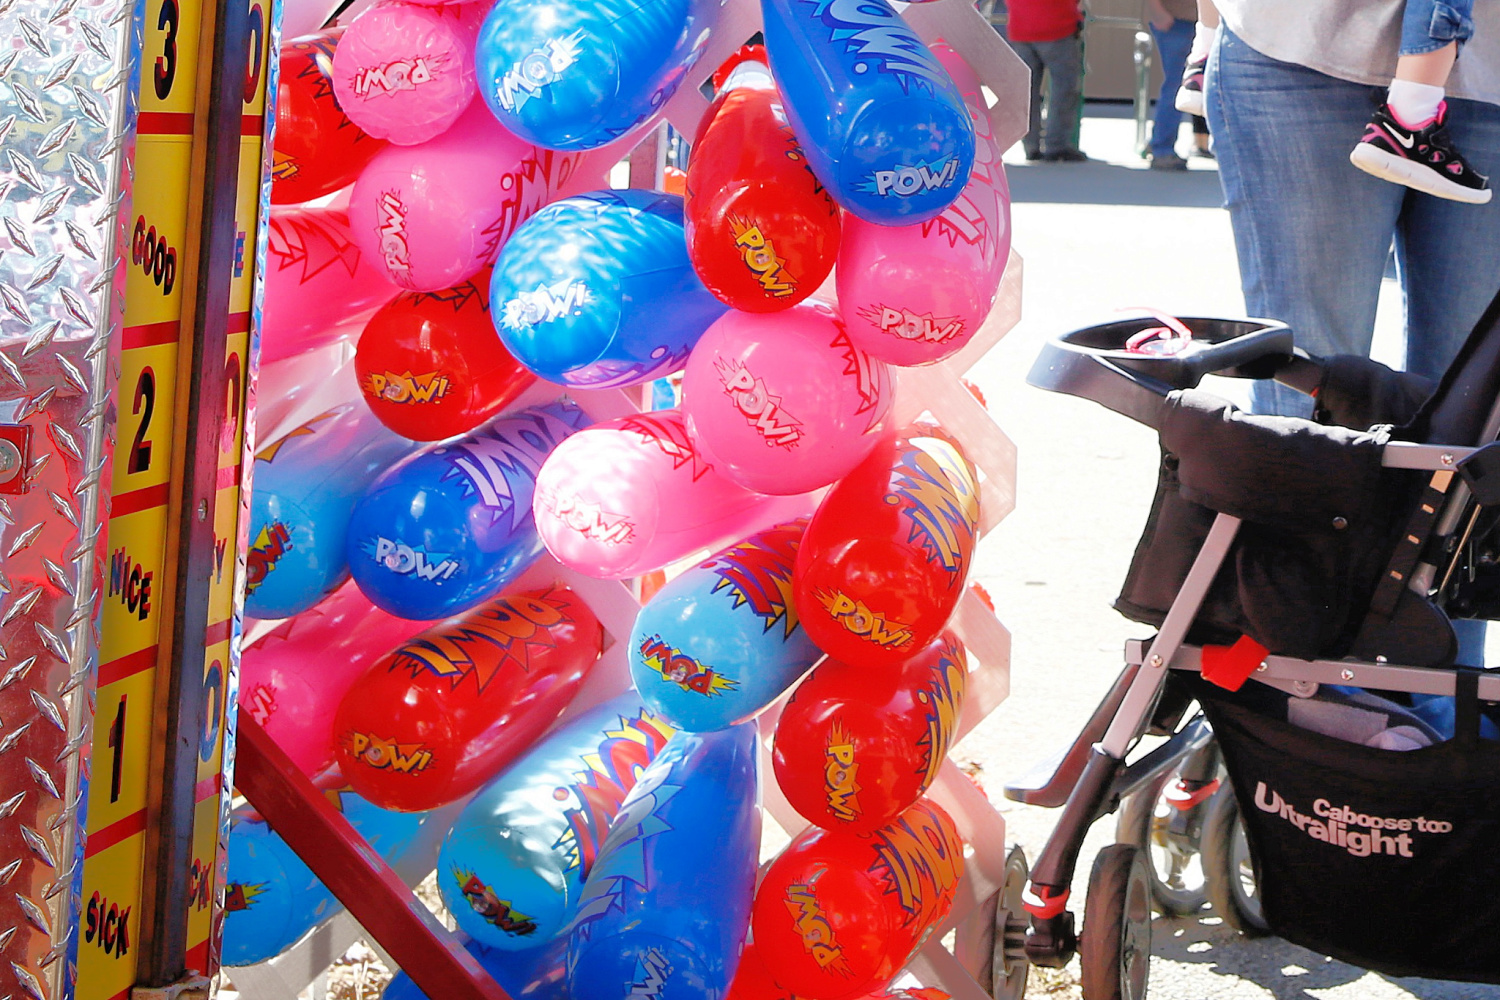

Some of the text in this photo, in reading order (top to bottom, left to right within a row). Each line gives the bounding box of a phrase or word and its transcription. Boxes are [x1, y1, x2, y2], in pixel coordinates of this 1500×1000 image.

[354, 57, 431, 95] POW!
[875, 159, 960, 198] POW!
[132, 214, 177, 296] GOOD
[380, 192, 410, 272] POW!
[736, 225, 794, 298] POW!
[506, 283, 588, 329] POW!
[879, 307, 964, 344] POW!
[128, 365, 156, 476] 2
[371, 373, 448, 405] POW!
[726, 369, 799, 448] POW!
[108, 545, 154, 622] NICE
[245, 521, 293, 595] OW!
[375, 537, 458, 585] POW!
[830, 592, 913, 650] POW!
[640, 634, 715, 696] POW!
[108, 693, 128, 805] 1
[353, 732, 433, 777] POW!
[826, 743, 858, 823] POW!
[1254, 780, 1413, 858] Ultralight
[1313, 798, 1453, 834] Caboose too
[85, 889, 132, 960] SICK
[788, 884, 841, 968] POW!
